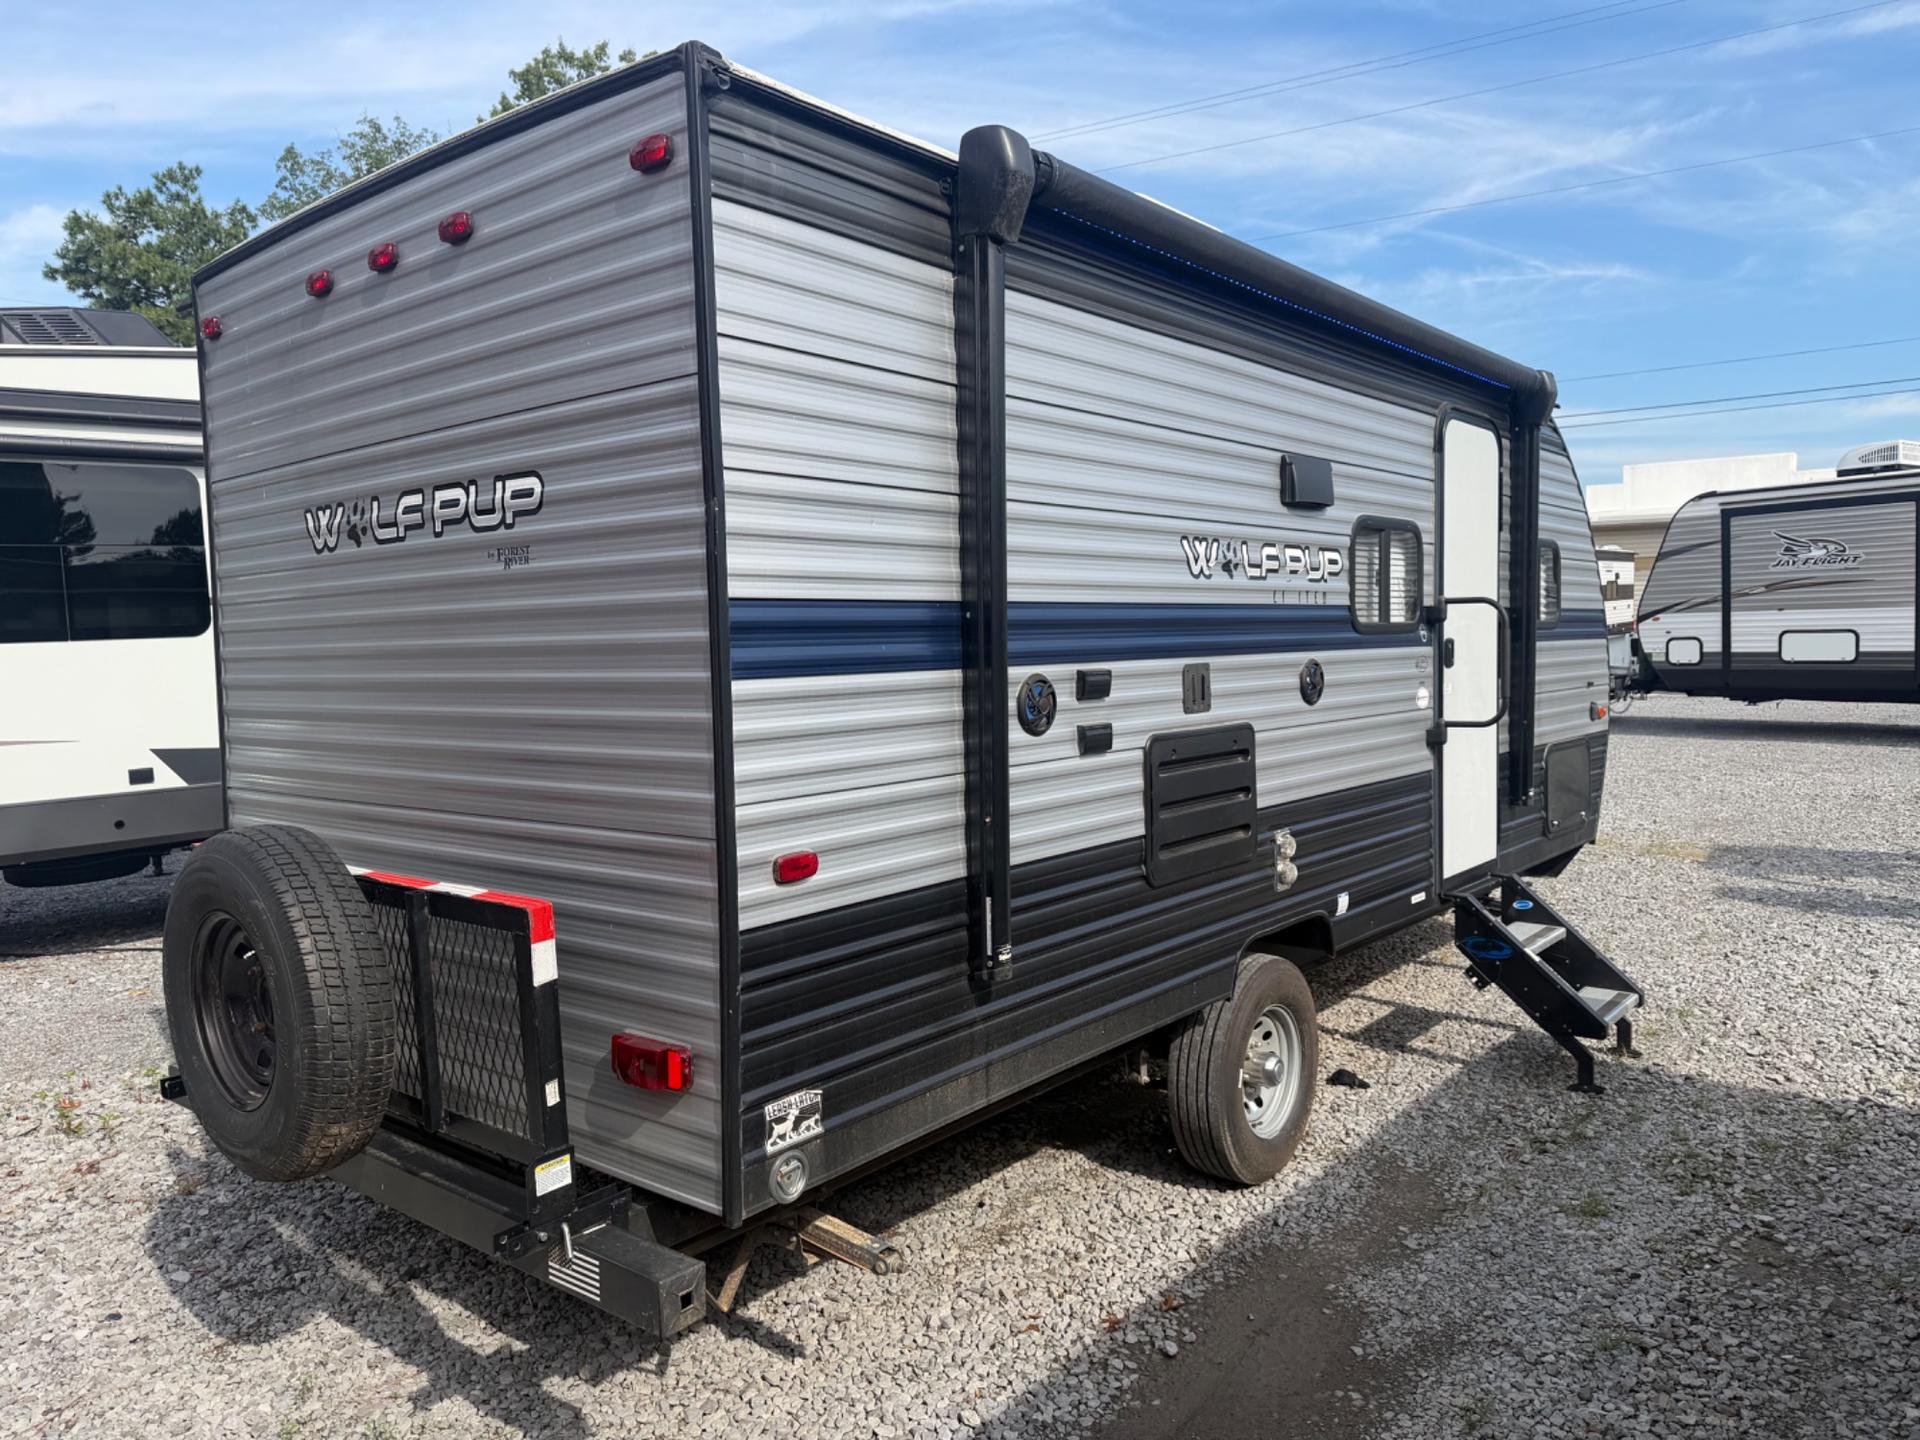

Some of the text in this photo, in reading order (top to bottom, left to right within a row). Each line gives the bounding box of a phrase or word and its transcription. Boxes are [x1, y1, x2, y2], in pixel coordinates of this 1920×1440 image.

[496, 545, 531, 563] FOREST
[503, 556, 531, 570] RIVER
[1771, 559, 1798, 568] JAY
[1802, 555, 1862, 566] FLIGHT
